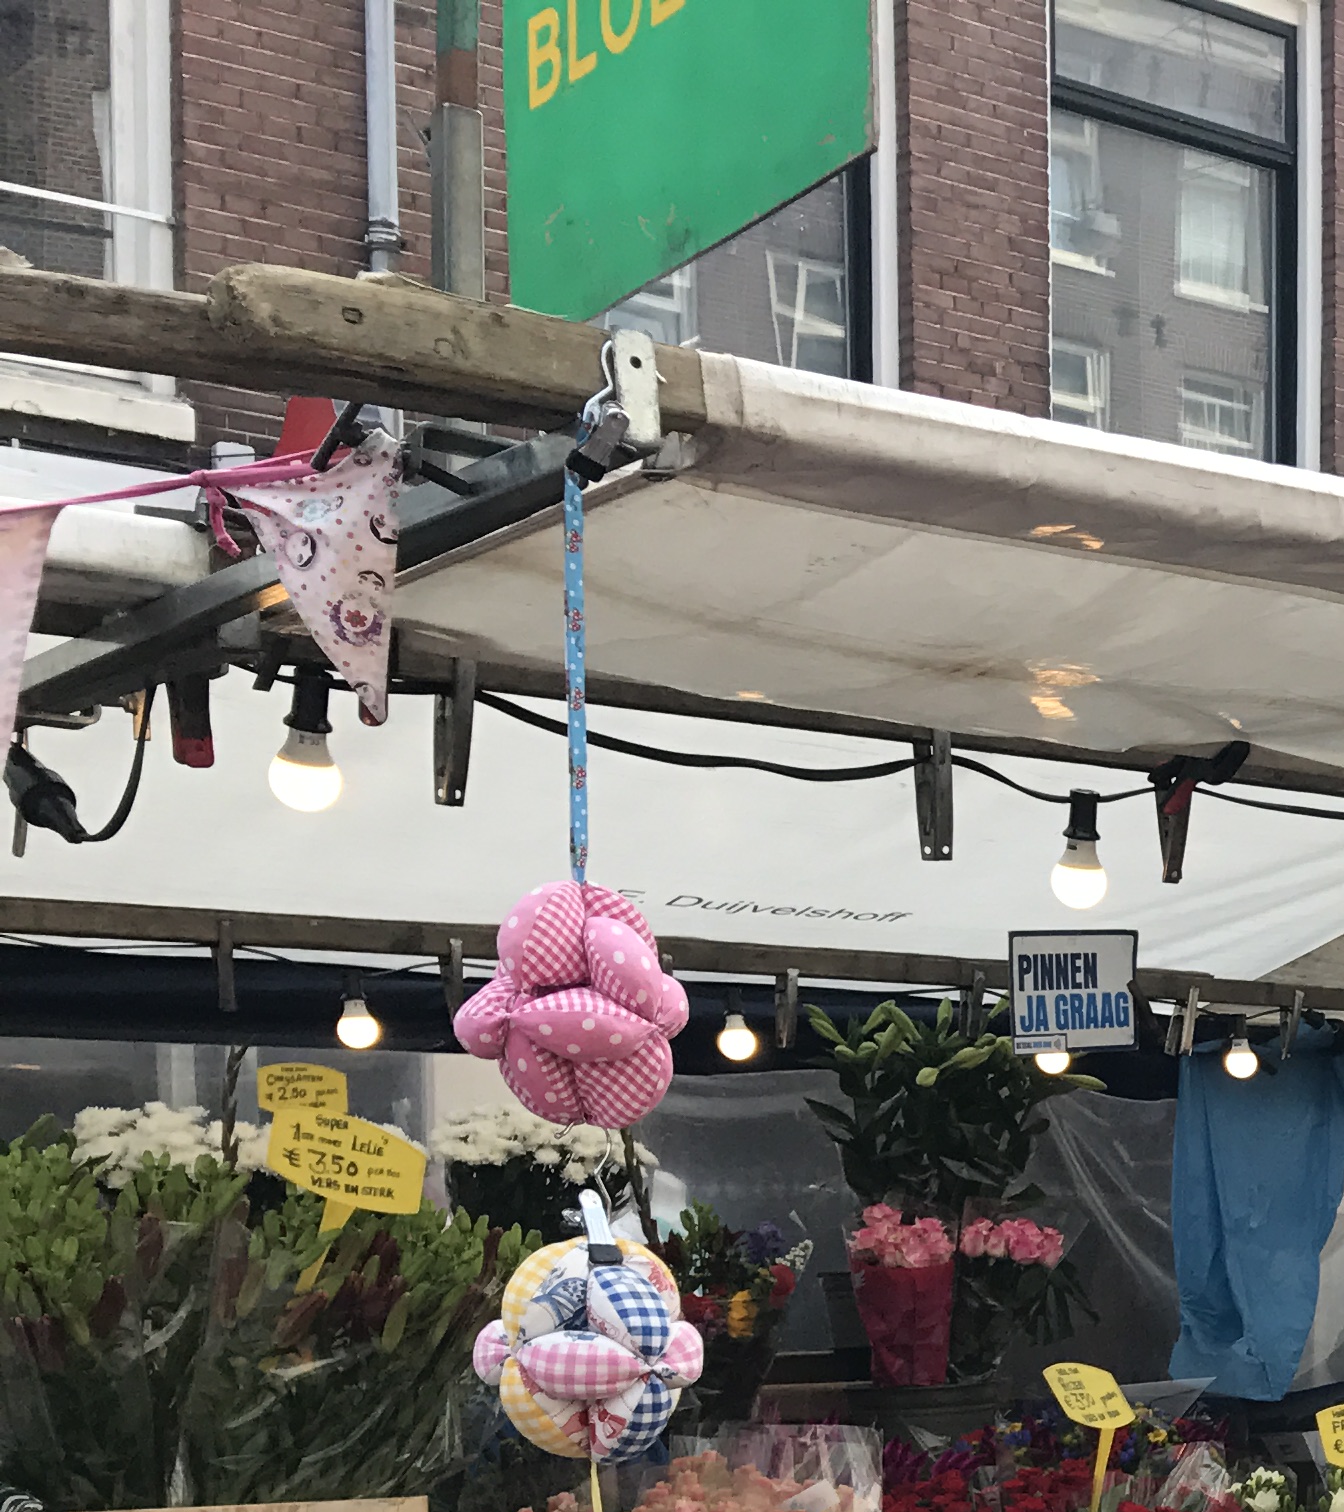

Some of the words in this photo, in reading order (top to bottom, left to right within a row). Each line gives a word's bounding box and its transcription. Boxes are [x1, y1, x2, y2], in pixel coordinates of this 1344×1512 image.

[527, 0, 687, 110] BLO
[665, 894, 913, 923] Duijvelshoff
[1018, 952, 1098, 992] PINNEN
[1020, 994, 1050, 1033] JA
[1054, 991, 1130, 1031] GRAAG
